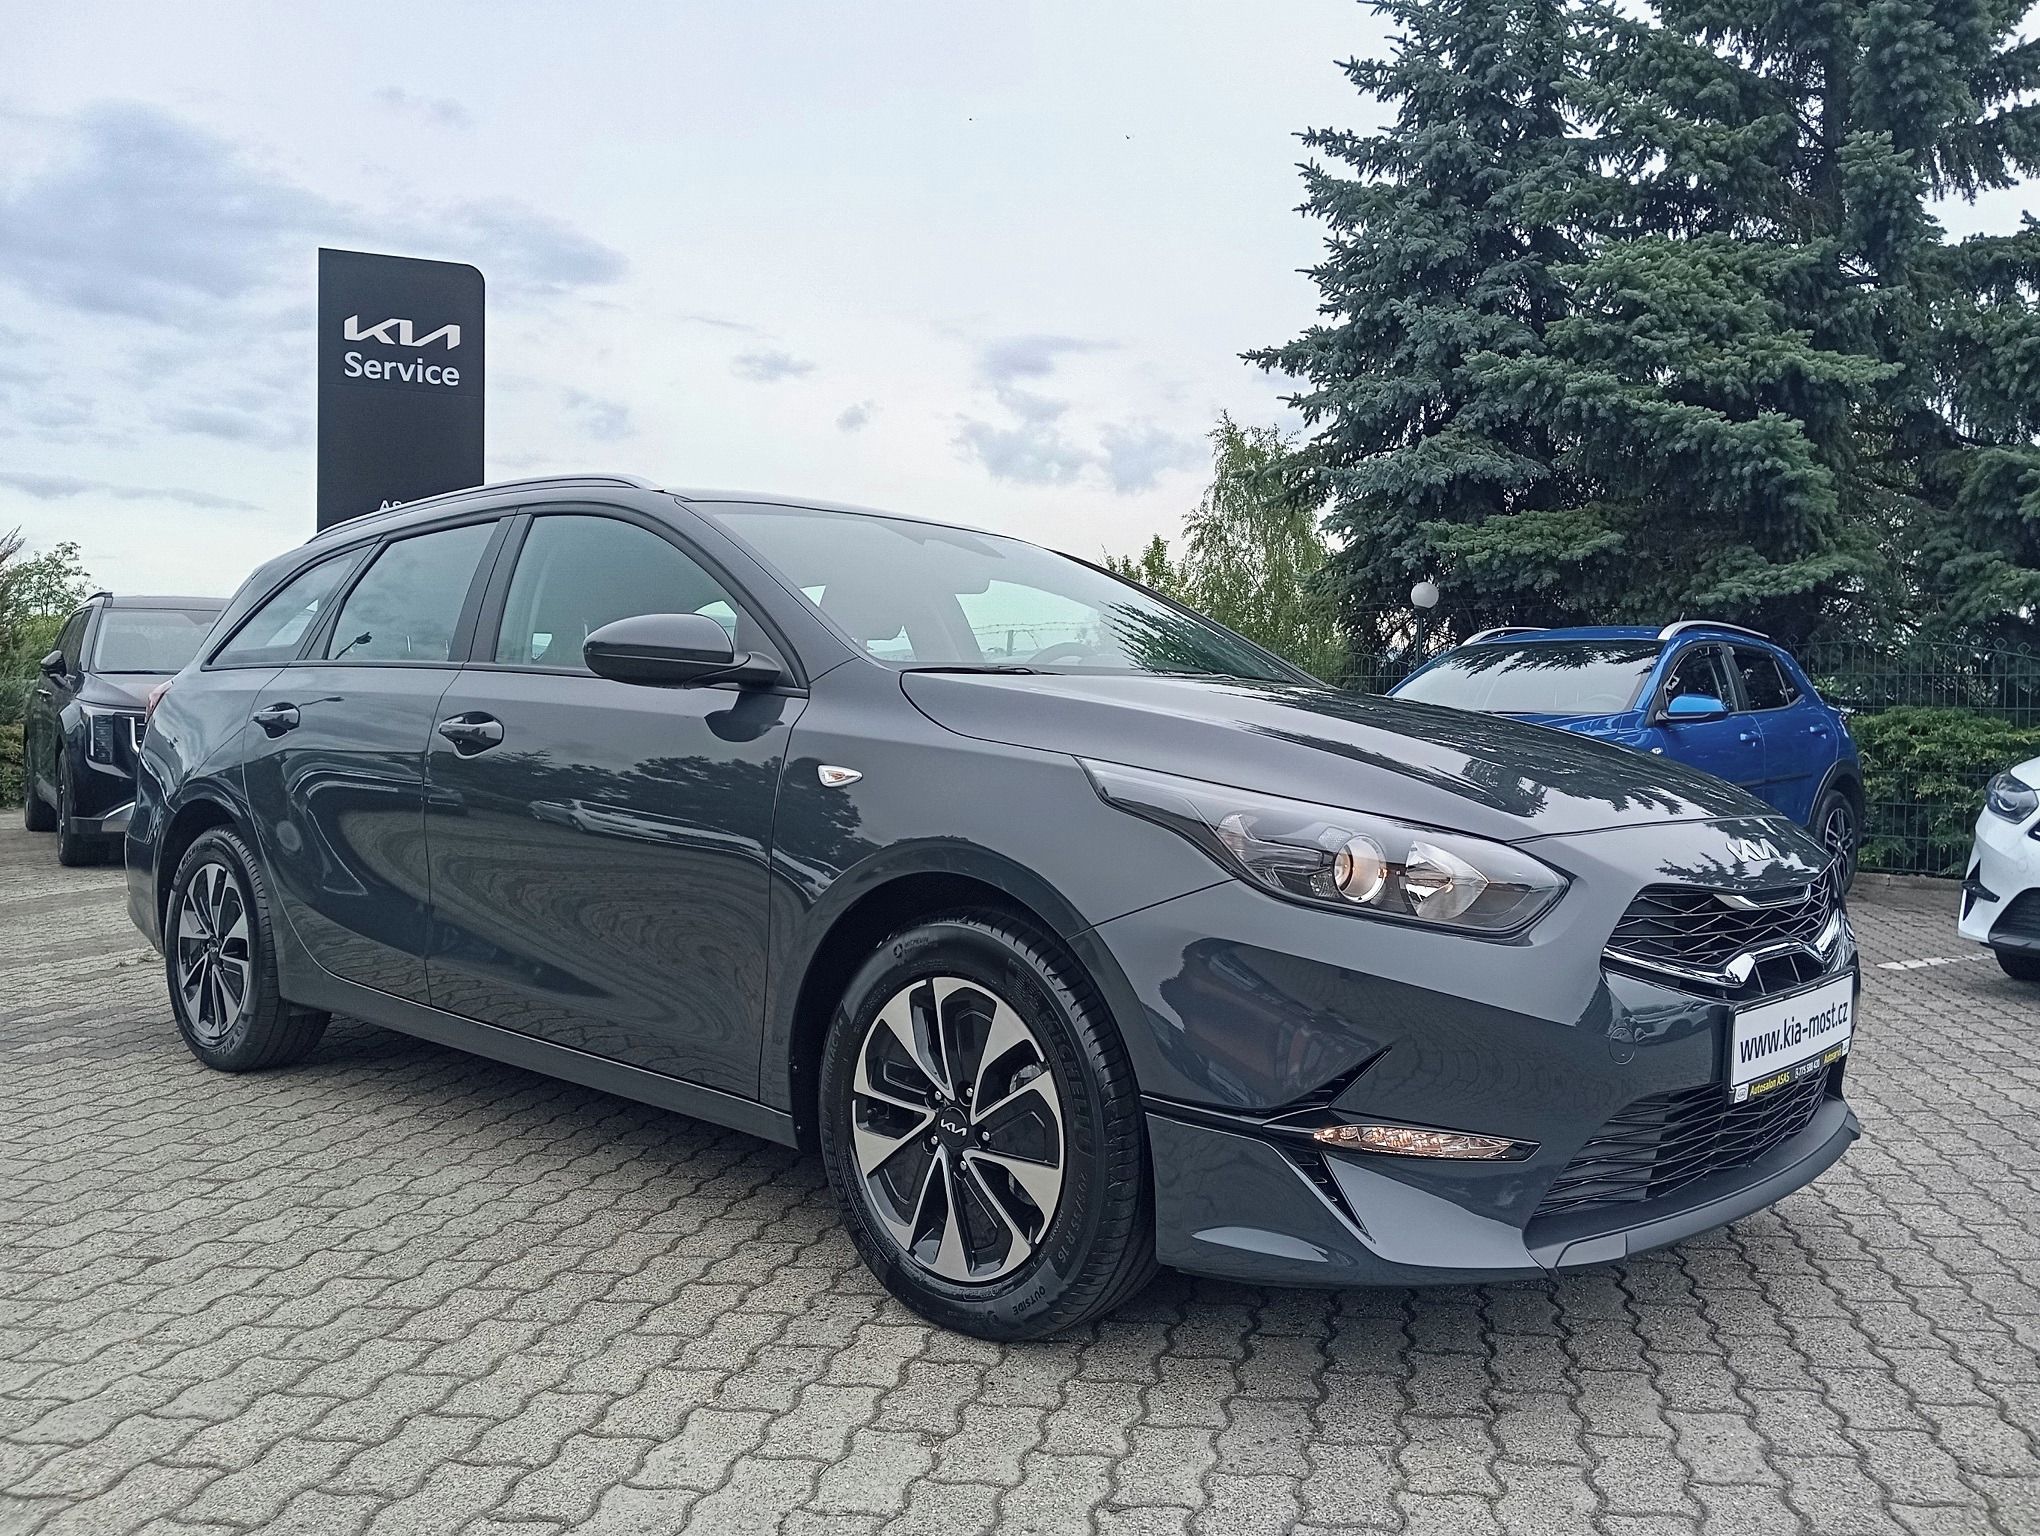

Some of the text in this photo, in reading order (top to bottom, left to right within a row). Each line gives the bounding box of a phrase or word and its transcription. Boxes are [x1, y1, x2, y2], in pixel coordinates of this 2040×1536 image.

[344, 314, 461, 350] KIA
[344, 351, 460, 386] Service
[1726, 838, 1781, 863] KIA
[1740, 1002, 1848, 1063] www.kia-most.cz
[1750, 1077, 1777, 1097] Autosalon
[1776, 1071, 1790, 1086] ASAS
[940, 1118, 968, 1137] KIA
[1057, 1246, 1070, 1264] 16
[1012, 1285, 1046, 1316] OUTSIDE
